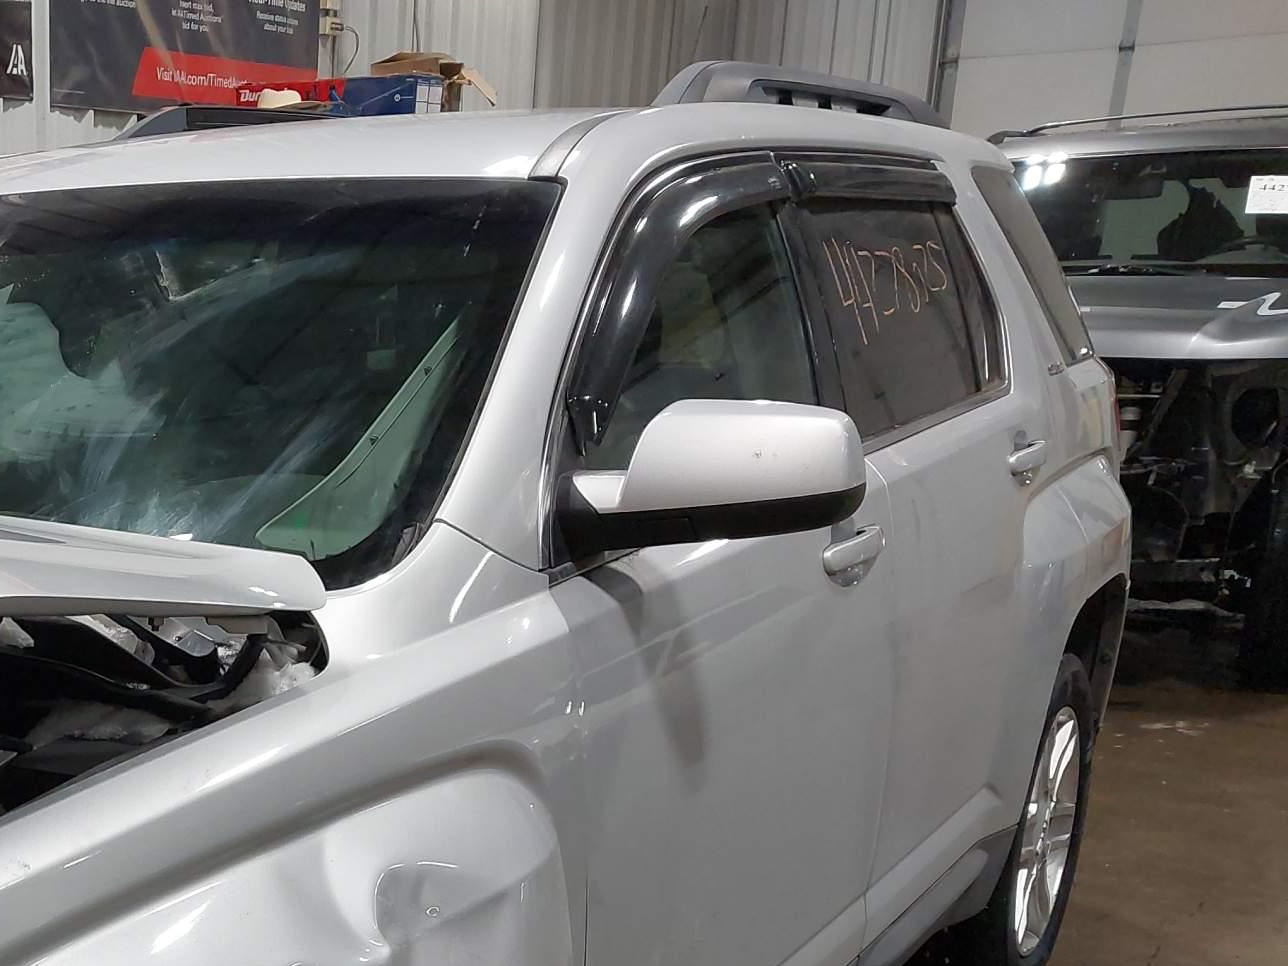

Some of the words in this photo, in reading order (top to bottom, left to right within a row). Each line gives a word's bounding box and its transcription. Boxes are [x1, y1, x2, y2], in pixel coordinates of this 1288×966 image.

[191, 19, 199, 30] for
[156, 66, 173, 81] Visit
[1258, 183, 1288, 192] 442
